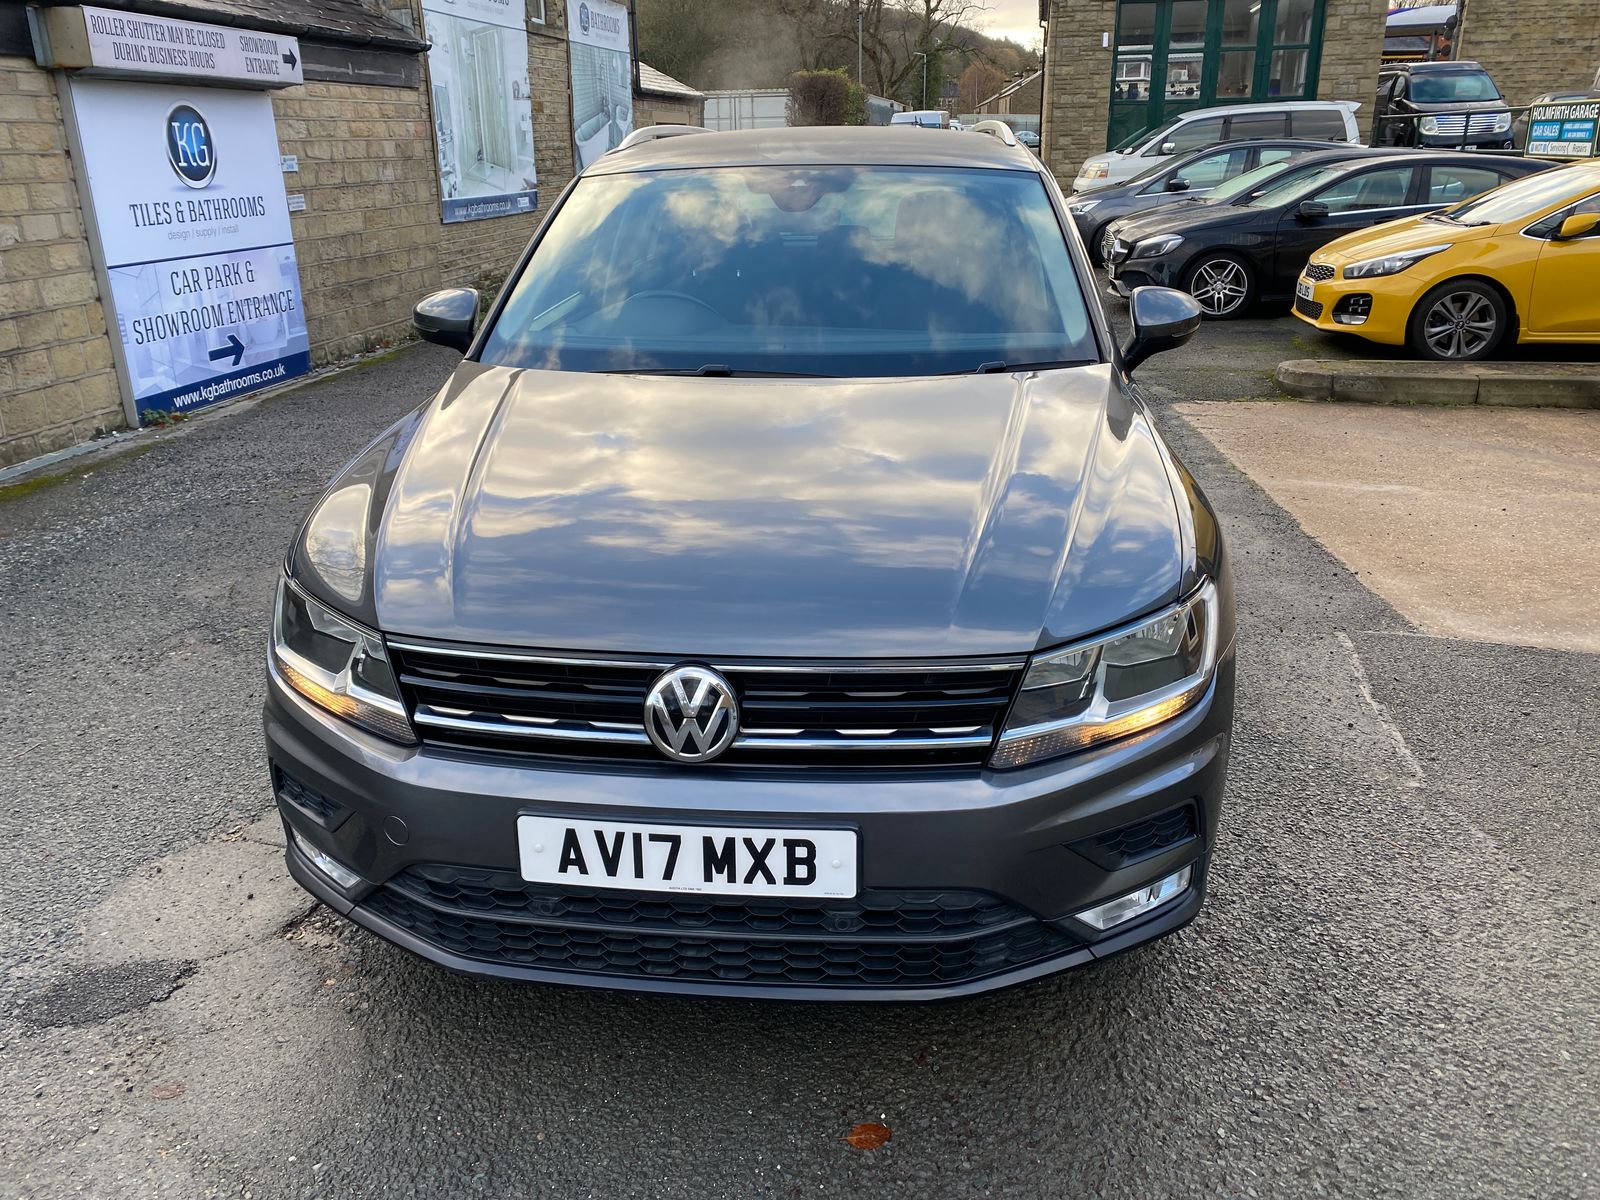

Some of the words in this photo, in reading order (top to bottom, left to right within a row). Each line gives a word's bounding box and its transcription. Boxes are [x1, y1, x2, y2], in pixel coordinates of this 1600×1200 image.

[90, 15, 126, 36] ROLLER
[127, 20, 166, 42] SHUTTER
[166, 26, 185, 44] MAY
[184, 28, 197, 45] BE
[197, 30, 225, 49] CLOSED
[239, 36, 279, 55] SHOWROOM
[112, 42, 147, 62] DURING
[148, 46, 188, 66] BUSINESS
[189, 53, 215, 69] HOURS
[245, 57, 280, 75] ENTRANCE
[1533, 106, 1570, 120] HOLMFIRTH
[1570, 104, 1599, 119] GARAGE
[171, 122, 210, 167] KG
[1533, 126, 1543, 136] CAR
[1543, 125, 1559, 136] SALES
[129, 203, 172, 227] TILES
[175, 201, 184, 223] &
[187, 196, 265, 222] BATHROOMS
[168, 229, 191, 241] design
[196, 227, 217, 239] supply
[222, 224, 239, 234] install
[170, 268, 202, 295] CAR
[204, 263, 243, 290] PARK
[245, 260, 255, 282] &
[132, 304, 225, 345] SHOWROOM
[227, 289, 295, 325] ENTRANCE
[173, 363, 286, 408] www.kgbathrooms.co.uk
[558, 828, 682, 880] AV17
[702, 836, 817, 886] MXB
